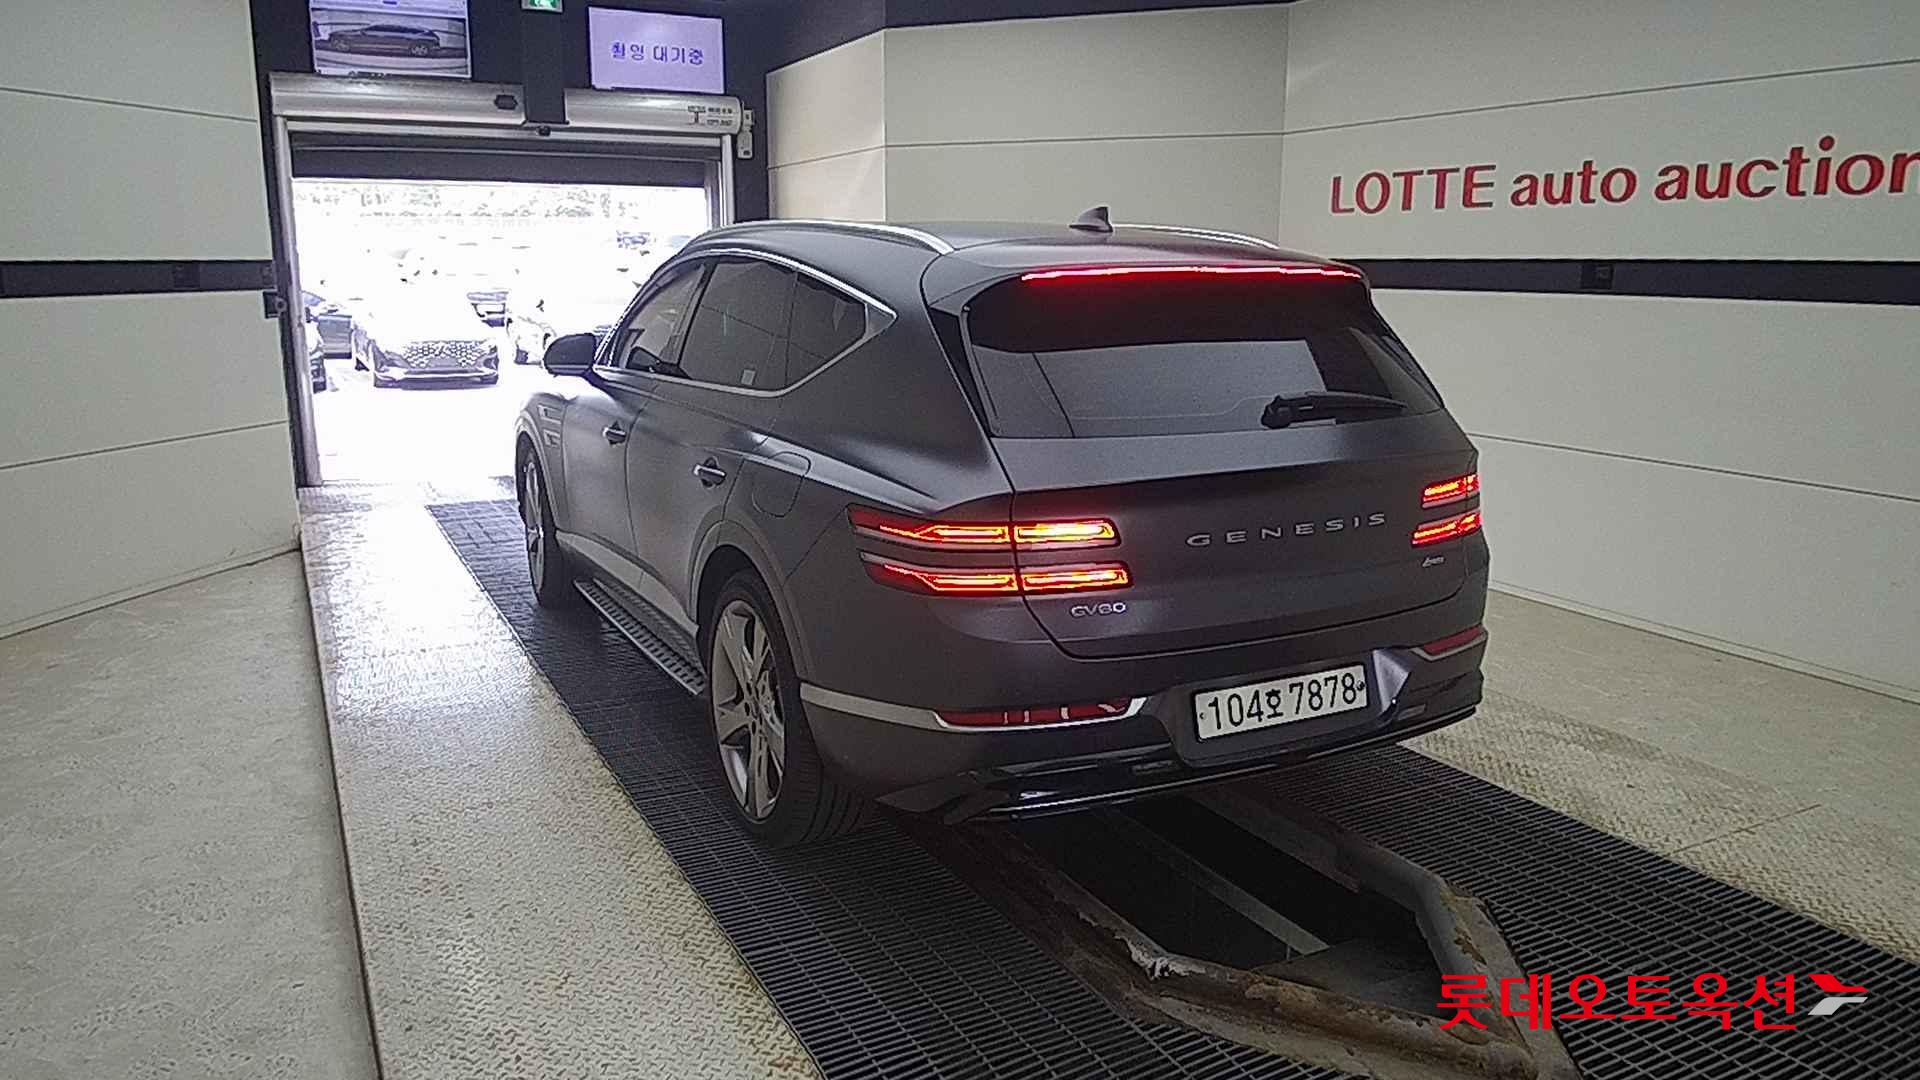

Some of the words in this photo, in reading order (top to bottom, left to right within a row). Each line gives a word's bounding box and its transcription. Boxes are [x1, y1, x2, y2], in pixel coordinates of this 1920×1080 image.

[652, 45, 704, 66] 대기중
[1331, 164, 1497, 214] LOTTE
[1511, 159, 1637, 206] auto
[1186, 512, 1386, 548] GENESIS
[1071, 602, 1127, 617] GV80
